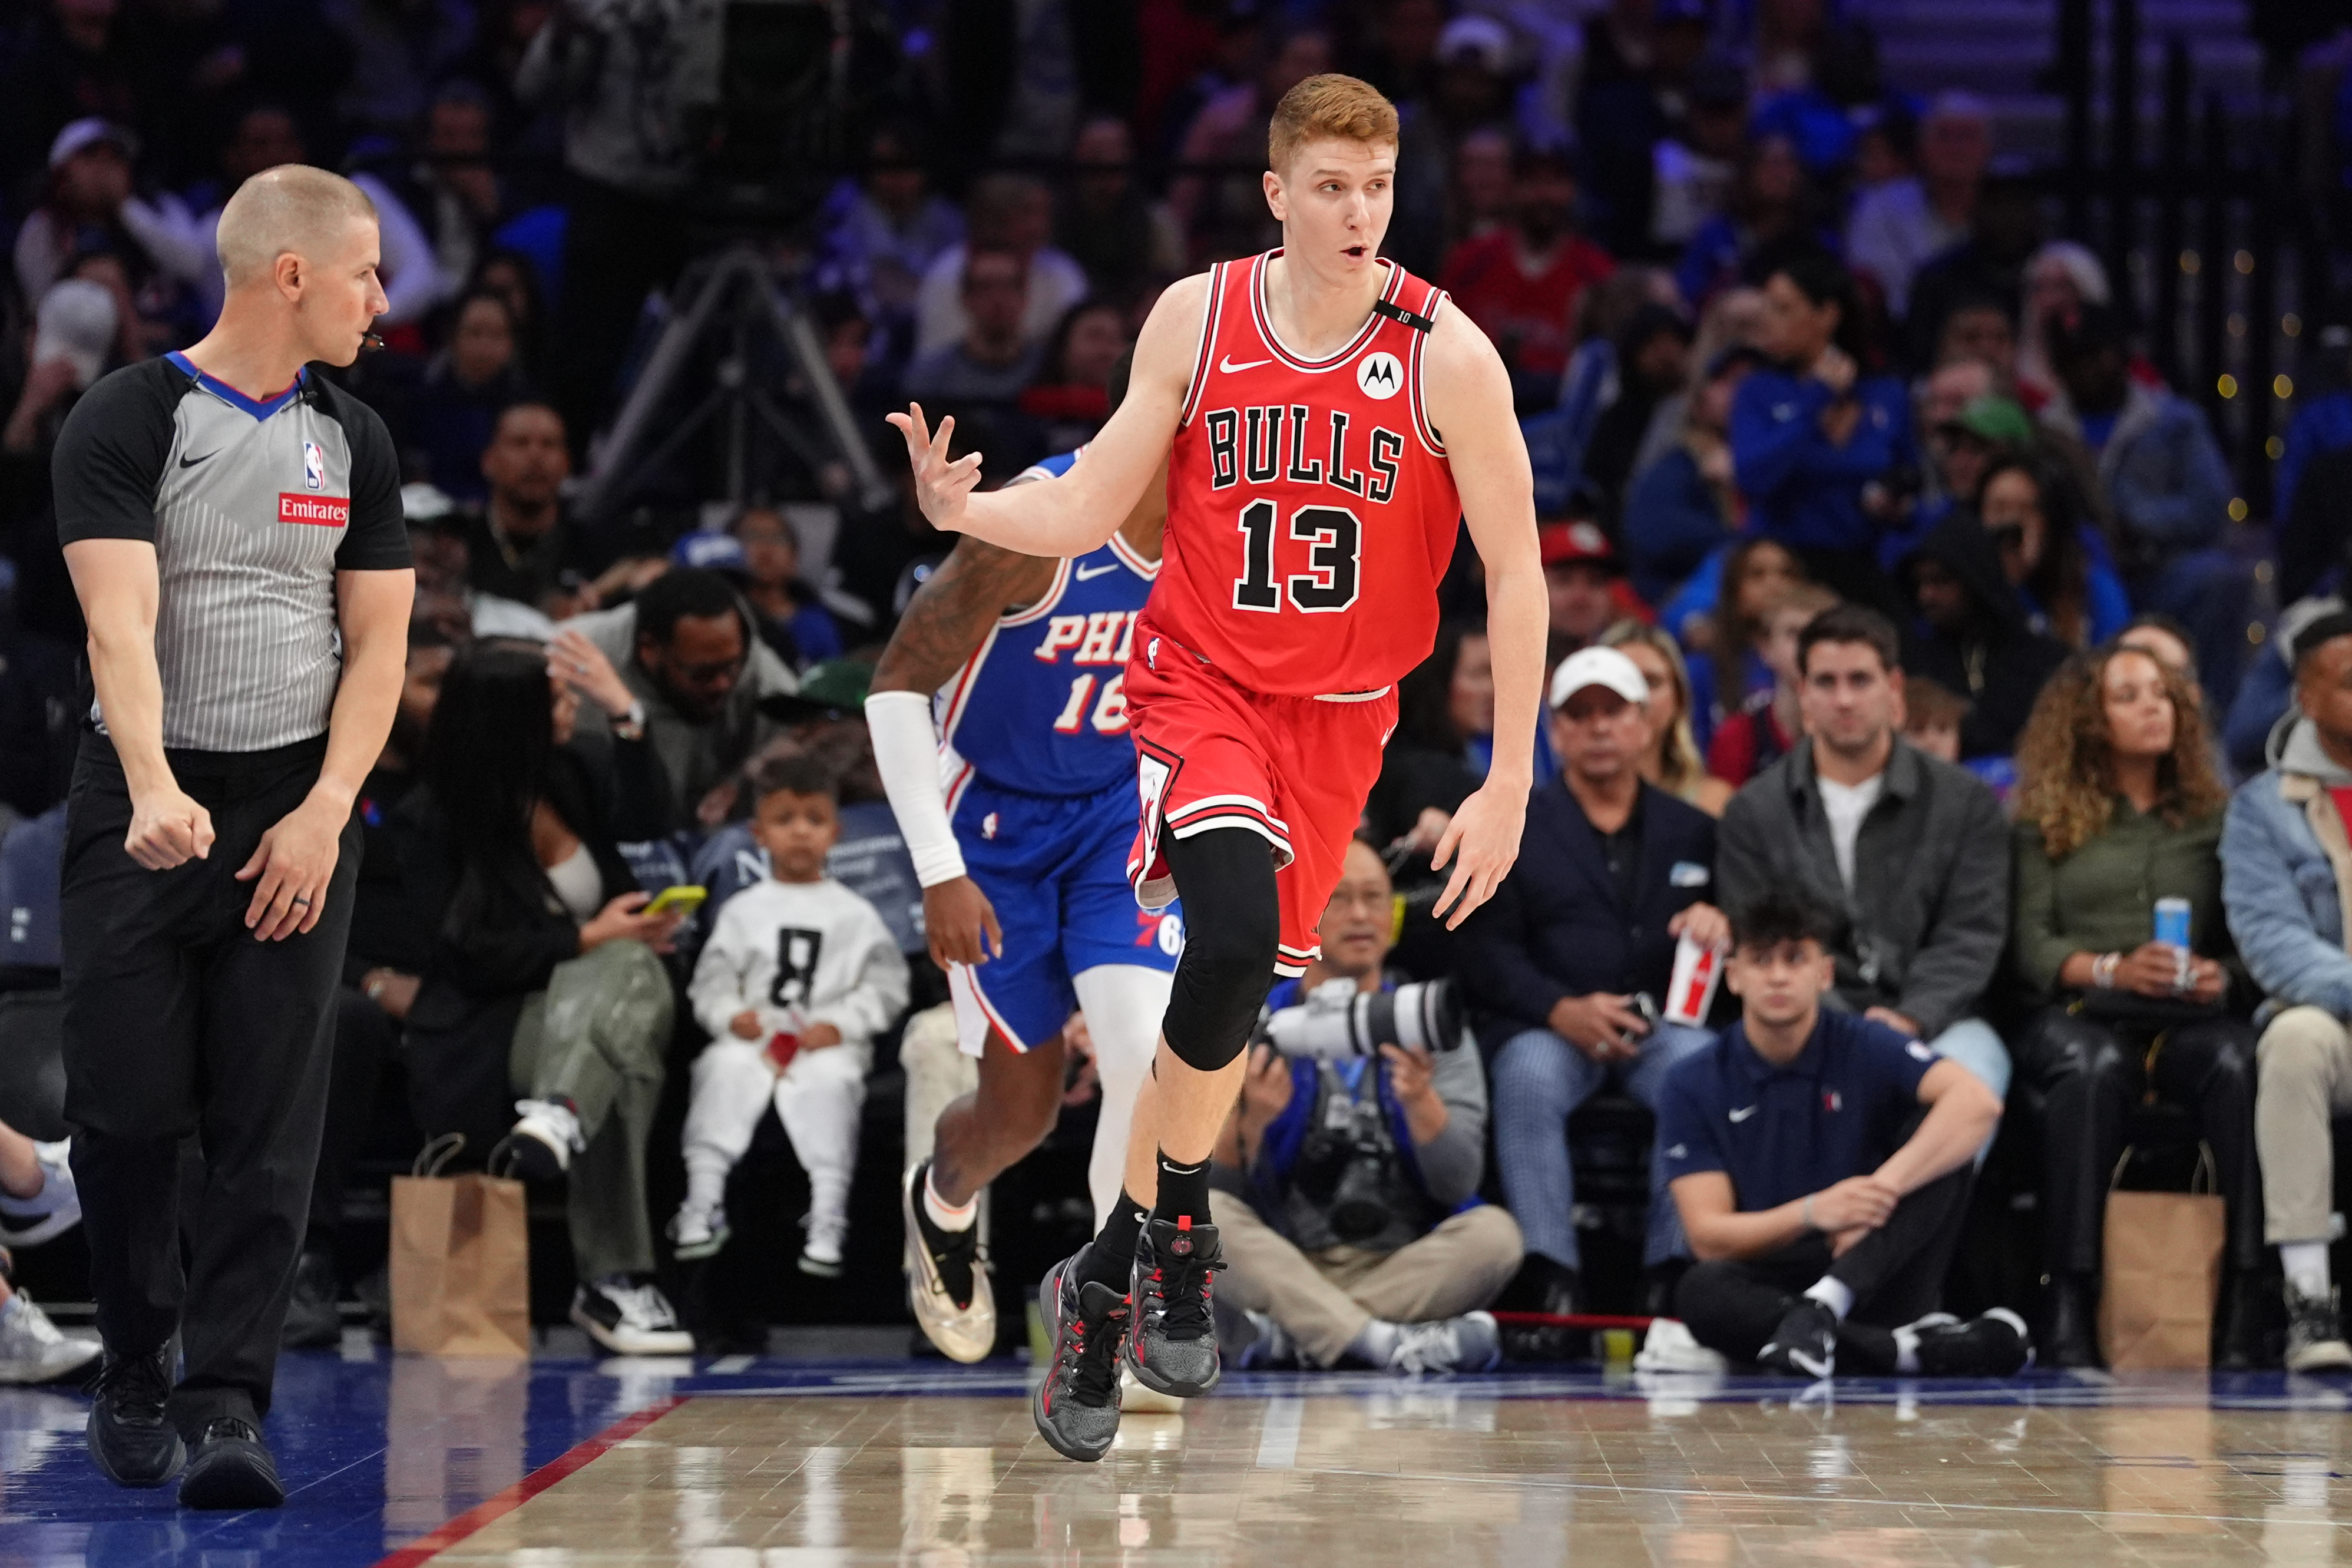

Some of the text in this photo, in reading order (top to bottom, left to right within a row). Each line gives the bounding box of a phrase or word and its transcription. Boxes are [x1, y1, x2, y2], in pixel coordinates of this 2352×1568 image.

[1397, 310, 1411, 324] 10
[1205, 404, 1405, 505] BULLS
[282, 498, 348, 521] Emirates
[1232, 498, 1362, 614] 13
[1053, 673, 1130, 736] 16
[1135, 909, 1181, 957] 76
